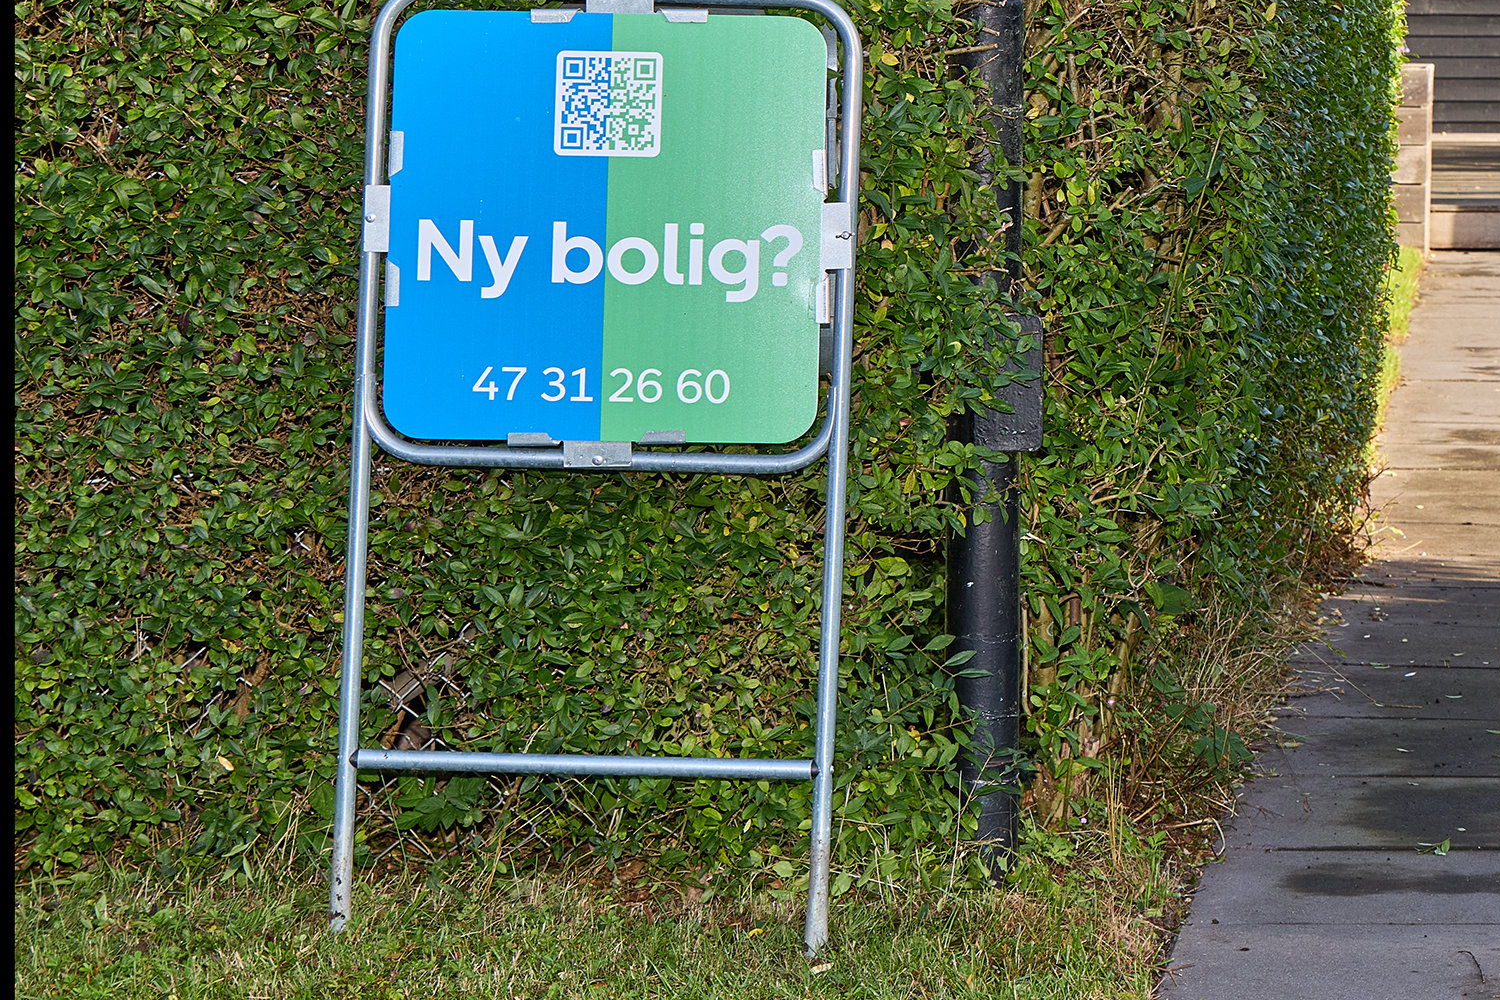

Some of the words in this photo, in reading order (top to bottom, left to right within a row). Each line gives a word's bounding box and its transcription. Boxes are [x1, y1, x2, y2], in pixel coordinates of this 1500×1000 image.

[416, 218, 529, 299] Ny
[551, 221, 804, 303] bolig?
[472, 366, 527, 401] 47
[540, 366, 594, 402] 31
[608, 367, 663, 403] 26
[676, 368, 731, 404] 60
